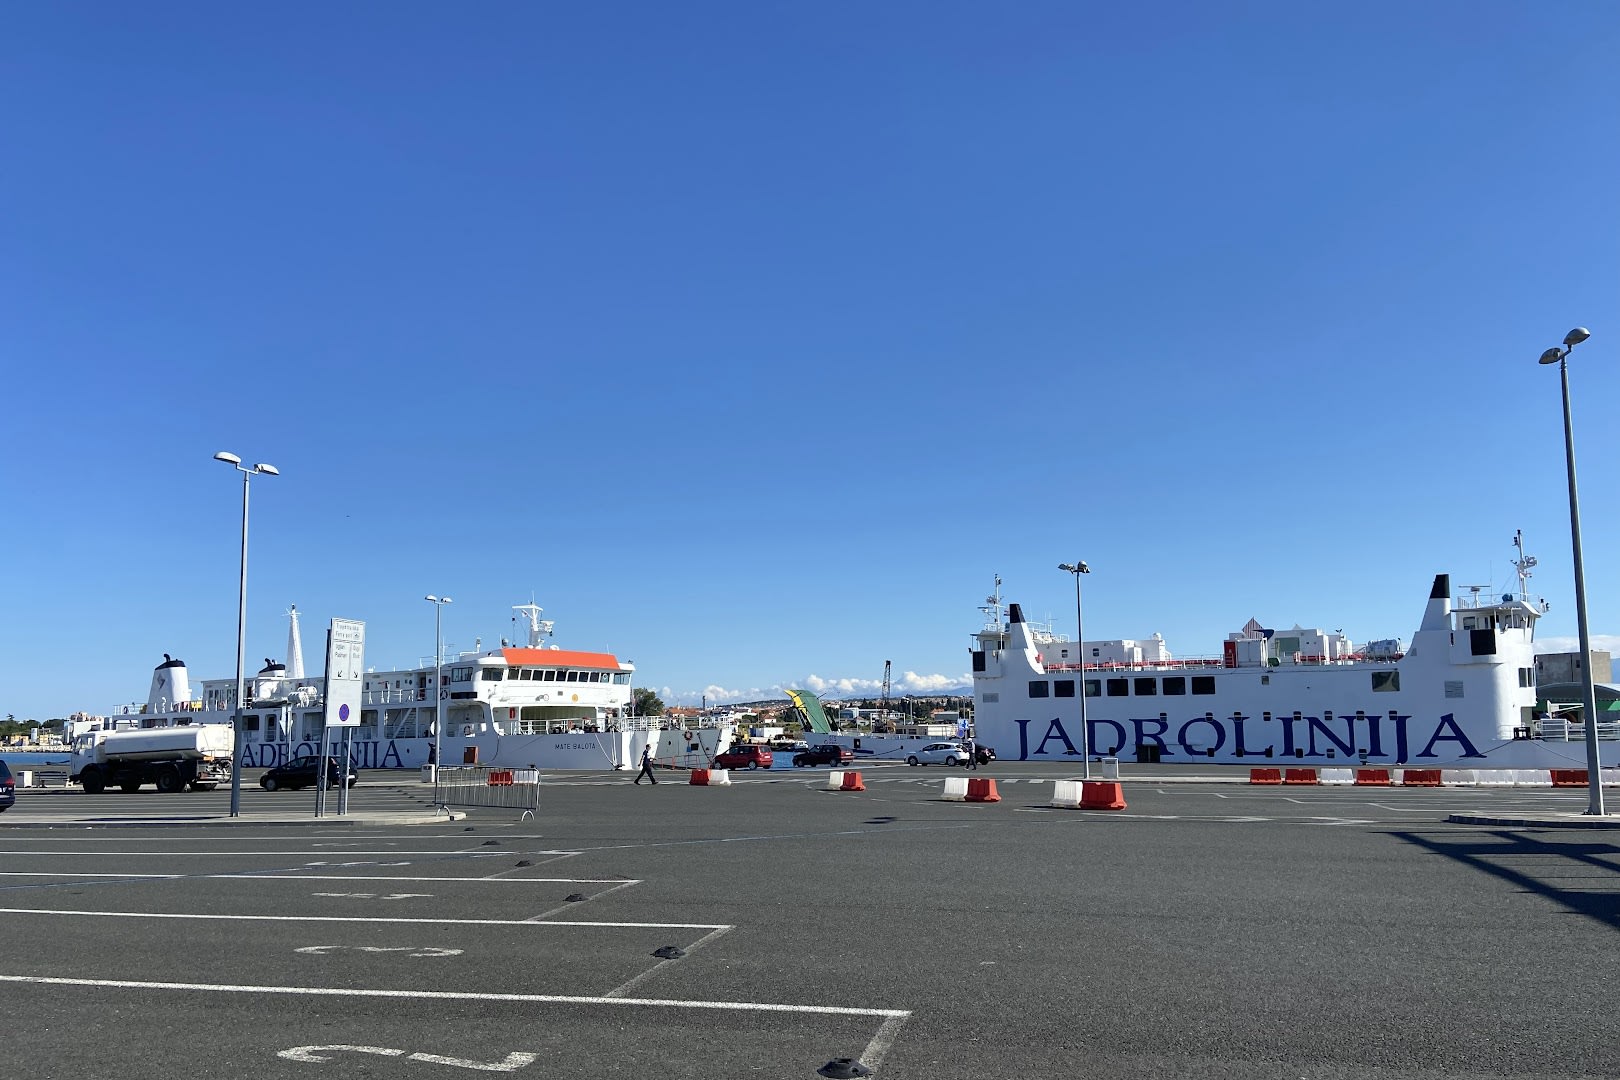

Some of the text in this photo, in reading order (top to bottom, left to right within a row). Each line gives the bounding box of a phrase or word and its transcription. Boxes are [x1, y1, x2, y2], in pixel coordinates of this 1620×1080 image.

[573, 742, 596, 750] BALOTA
[1014, 713, 1488, 764] JADROLINIJA
[276, 1044, 541, 1072] 2
